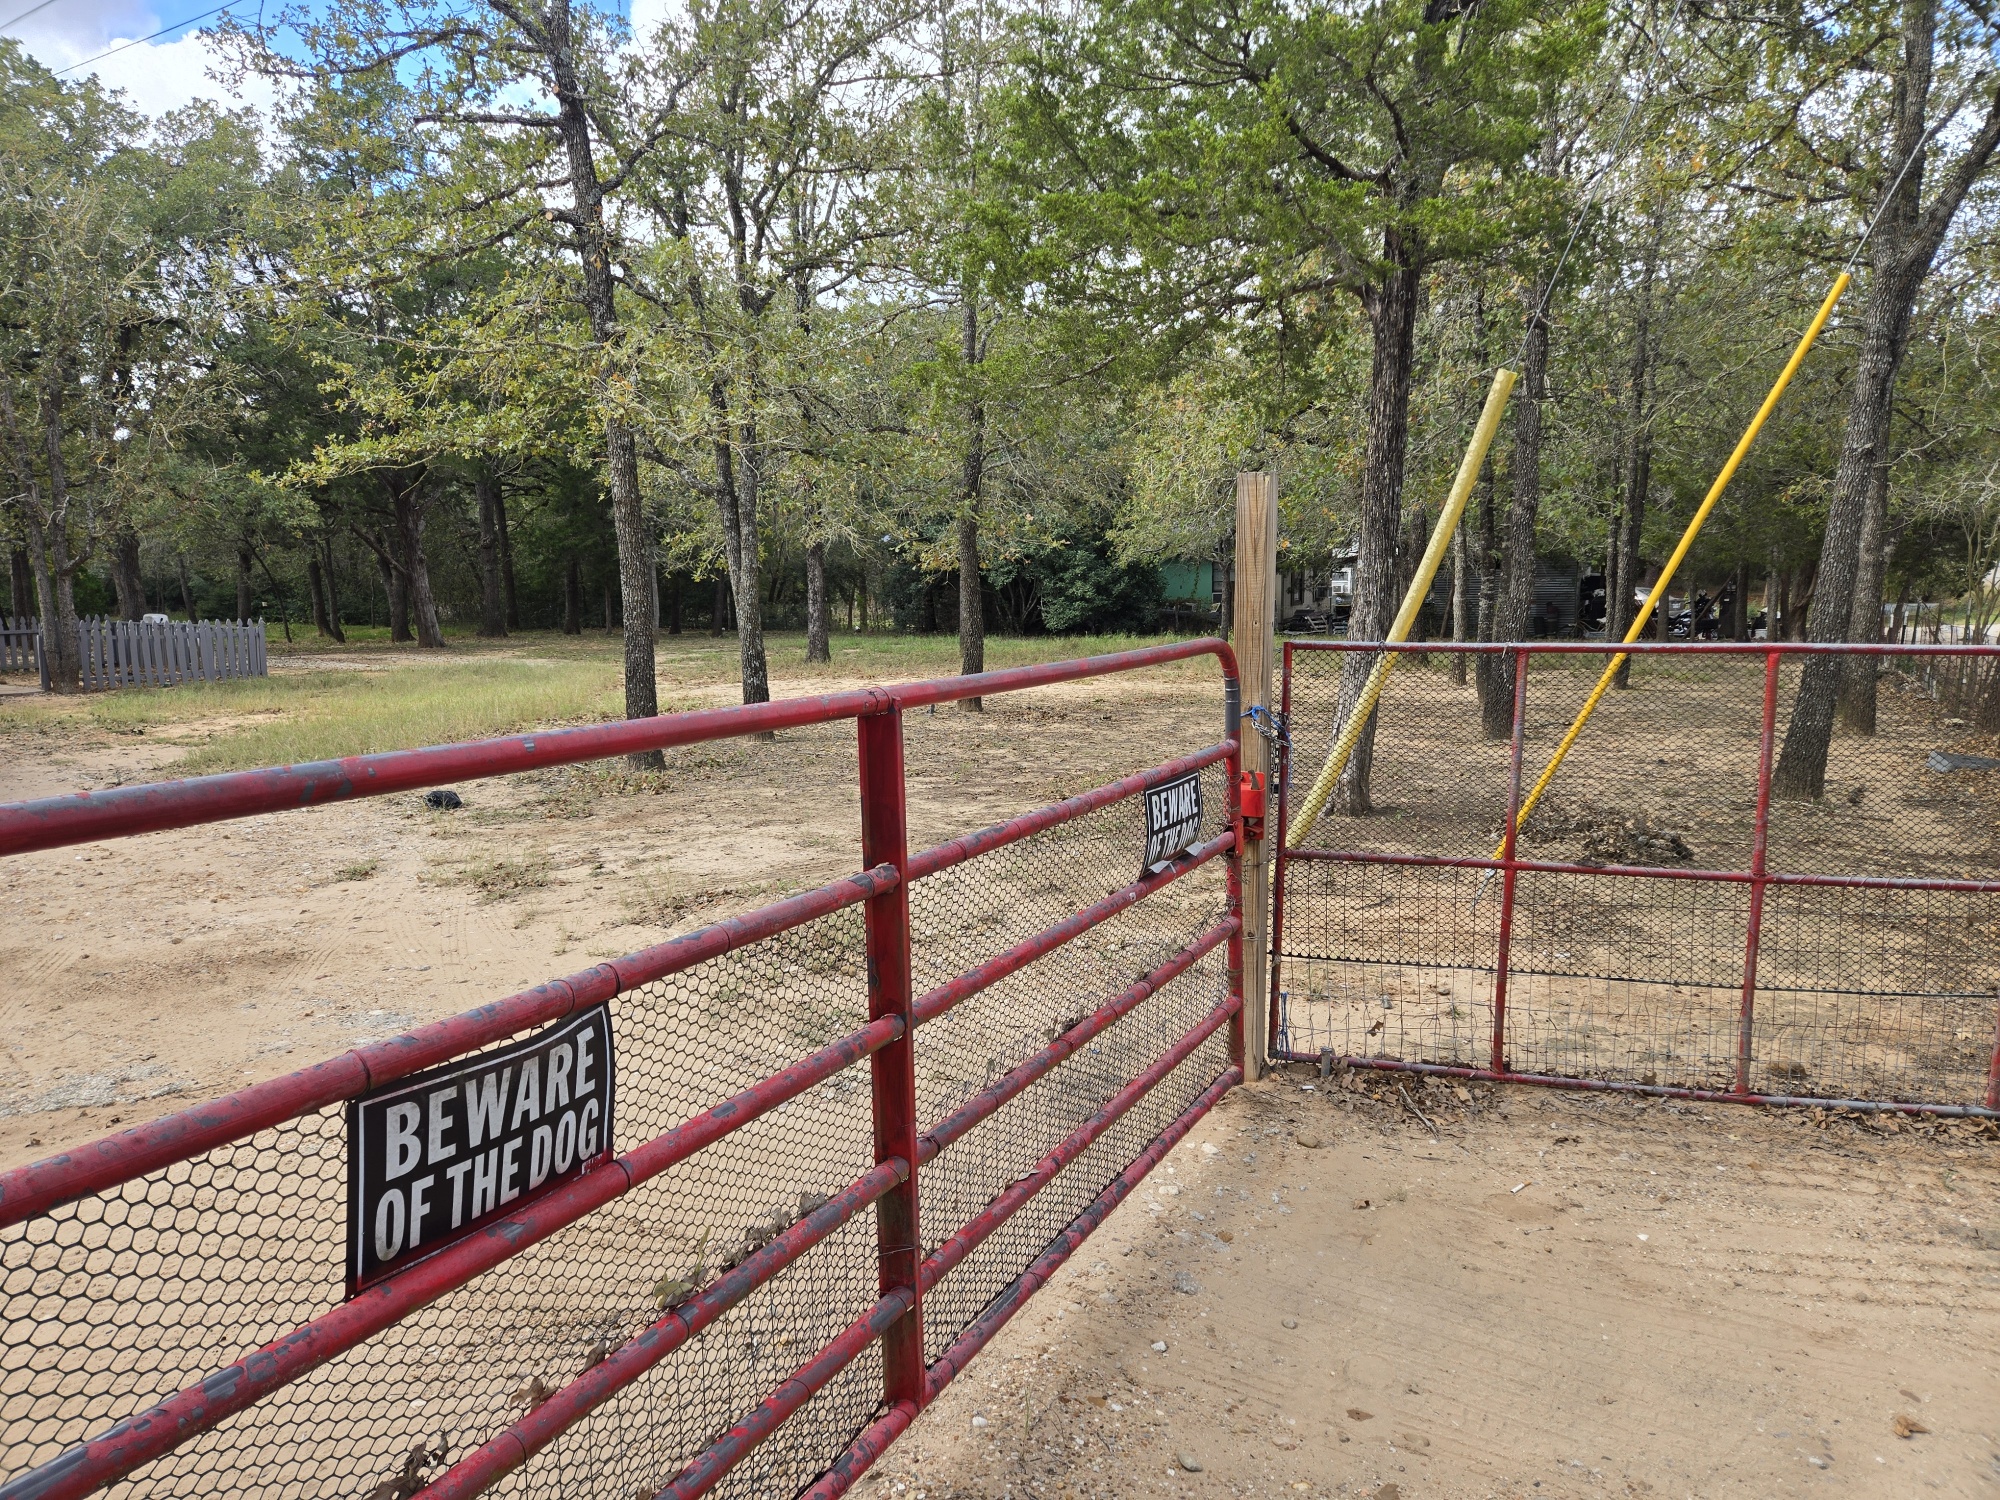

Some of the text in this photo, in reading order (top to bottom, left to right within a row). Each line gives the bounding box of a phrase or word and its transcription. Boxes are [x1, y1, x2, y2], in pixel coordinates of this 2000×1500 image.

[1148, 832, 1163, 866] OF
[1161, 825, 1181, 859] THE
[1151, 780, 1198, 831] BEWARE
[386, 1025, 596, 1181] BEWARE
[375, 1098, 599, 1261] OF THE DOG
